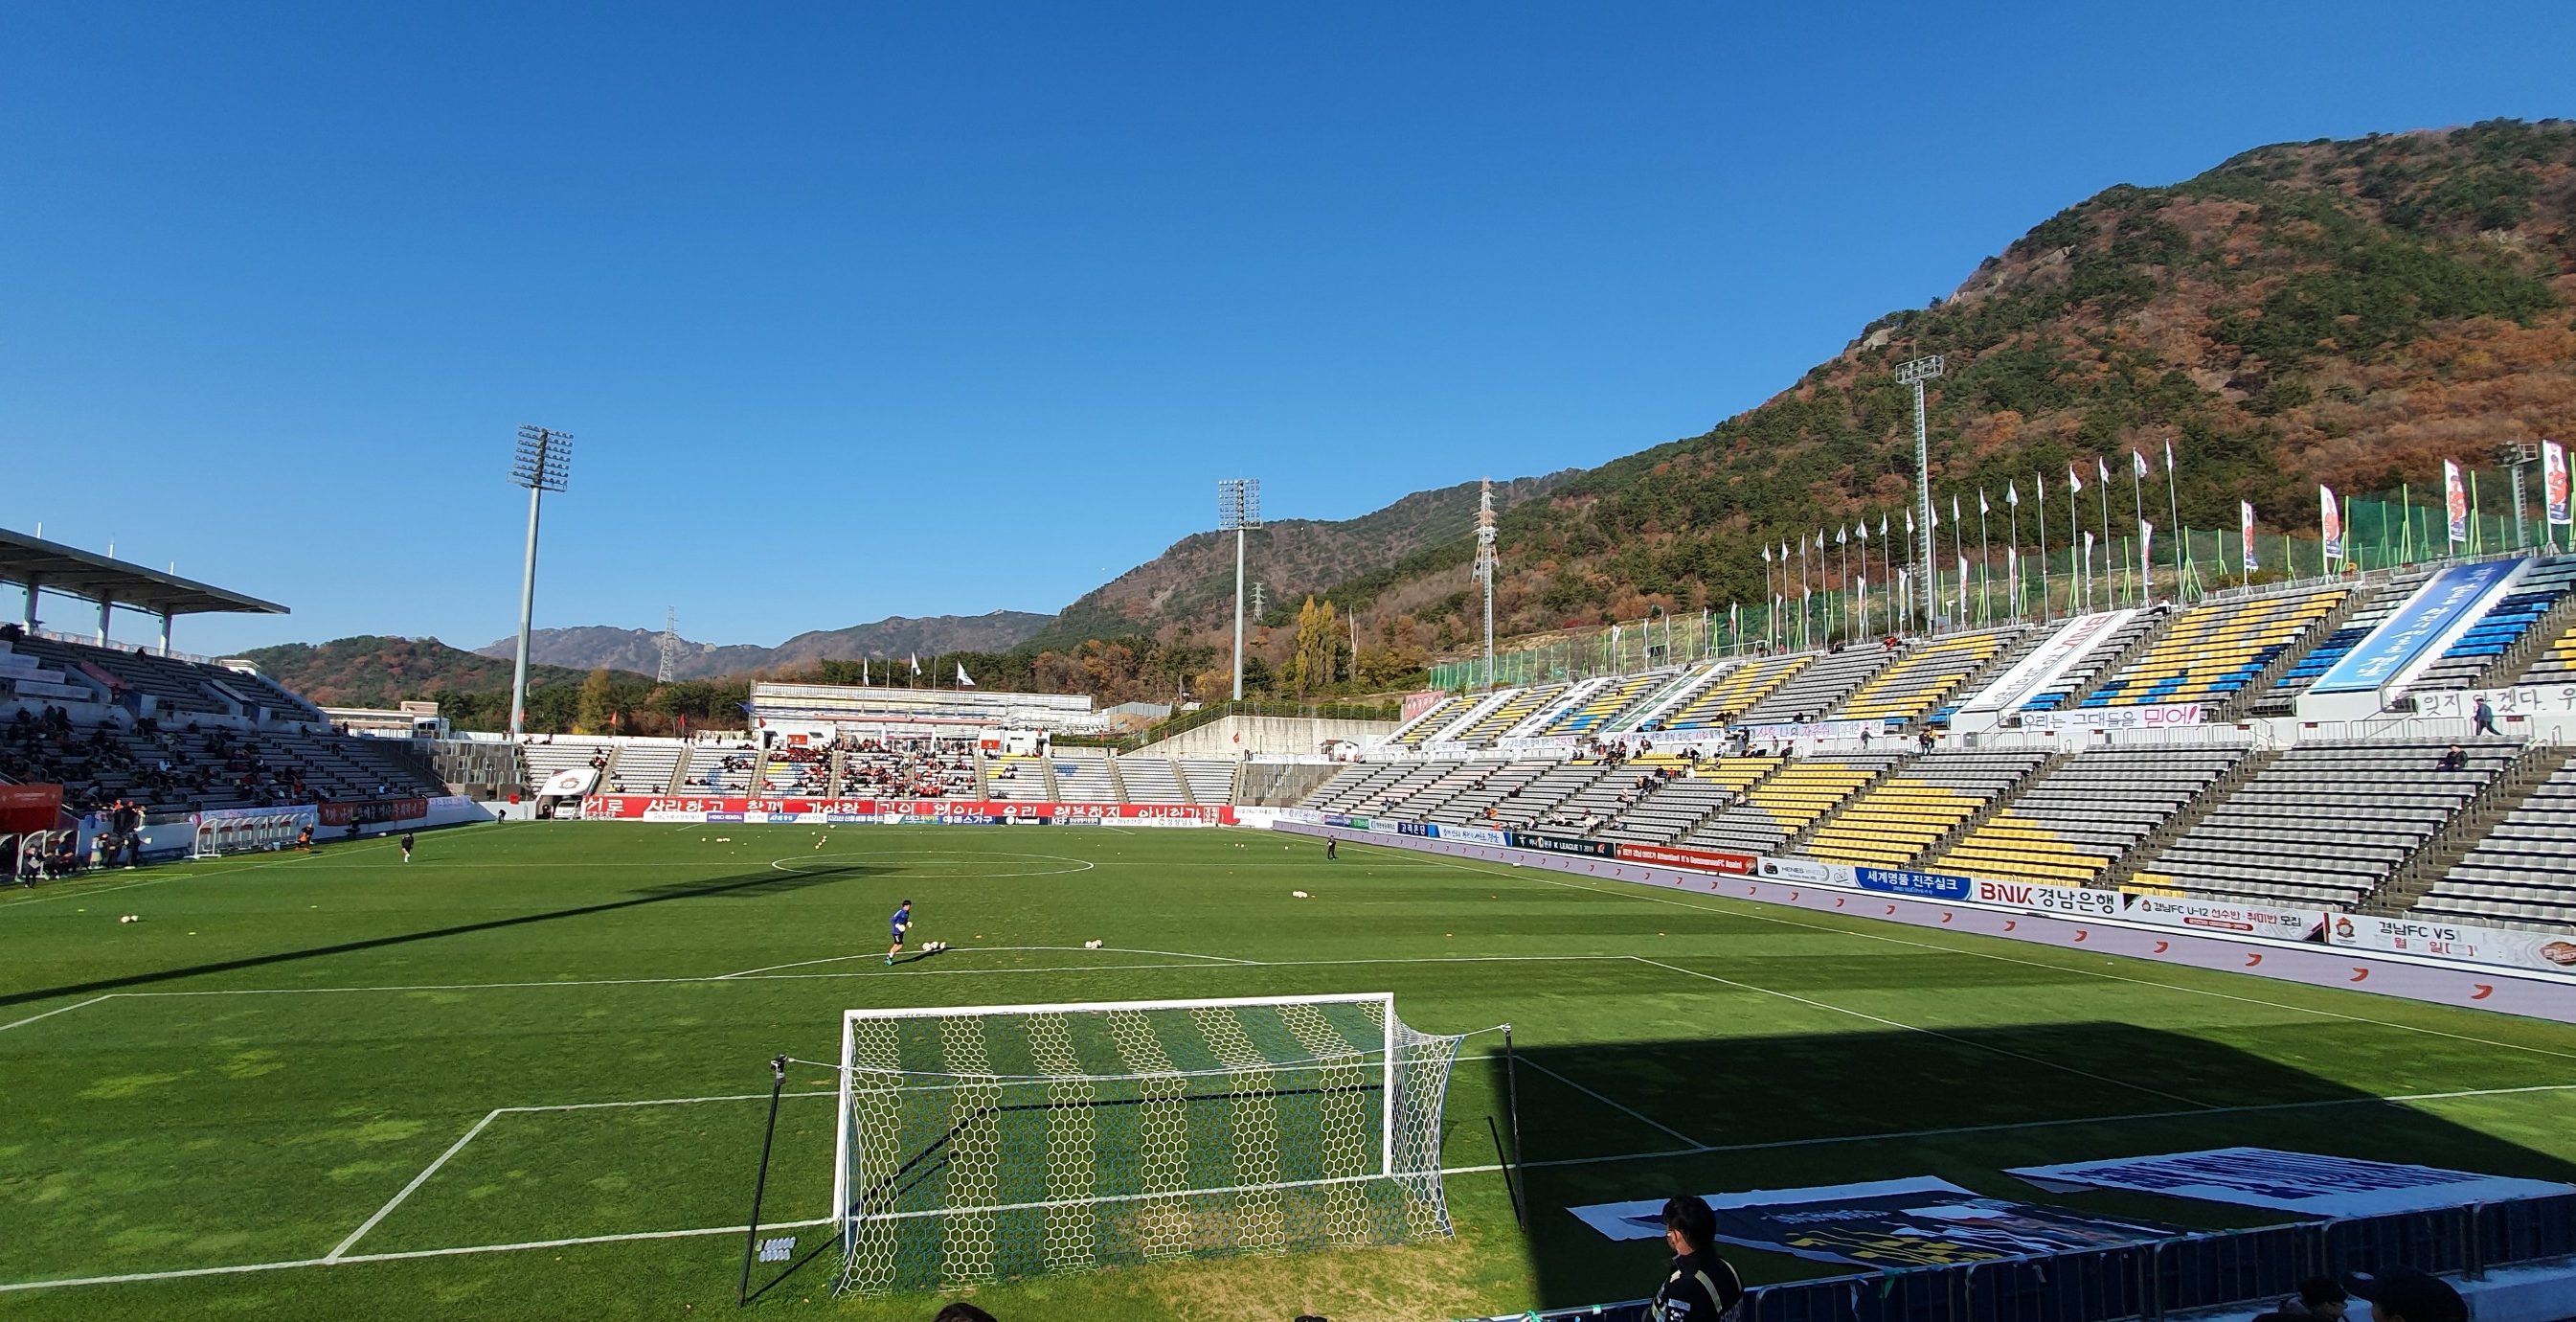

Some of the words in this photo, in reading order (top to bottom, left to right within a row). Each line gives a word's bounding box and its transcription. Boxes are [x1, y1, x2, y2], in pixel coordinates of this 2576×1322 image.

[2424, 693, 2462, 717] 잊지
[2022, 714, 2066, 731] 우리는
[2072, 711, 2136, 727] 그대들을
[2144, 705, 2199, 729] 믿어!
[1560, 842, 1578, 852] LEAGUE
[1868, 871, 1909, 886] 세계명품
[1912, 876, 1957, 890] 진주실크
[1980, 881, 2034, 905] BNK
[2039, 890, 2114, 915] 경남은행
[2154, 901, 2184, 915] 경남FC
[2187, 906, 2208, 917] U-12
[2211, 908, 2240, 921] 선수반
[2280, 916, 2302, 927] 모집
[2379, 921, 2429, 938] 경남FC
[2433, 928, 2455, 940] VS
